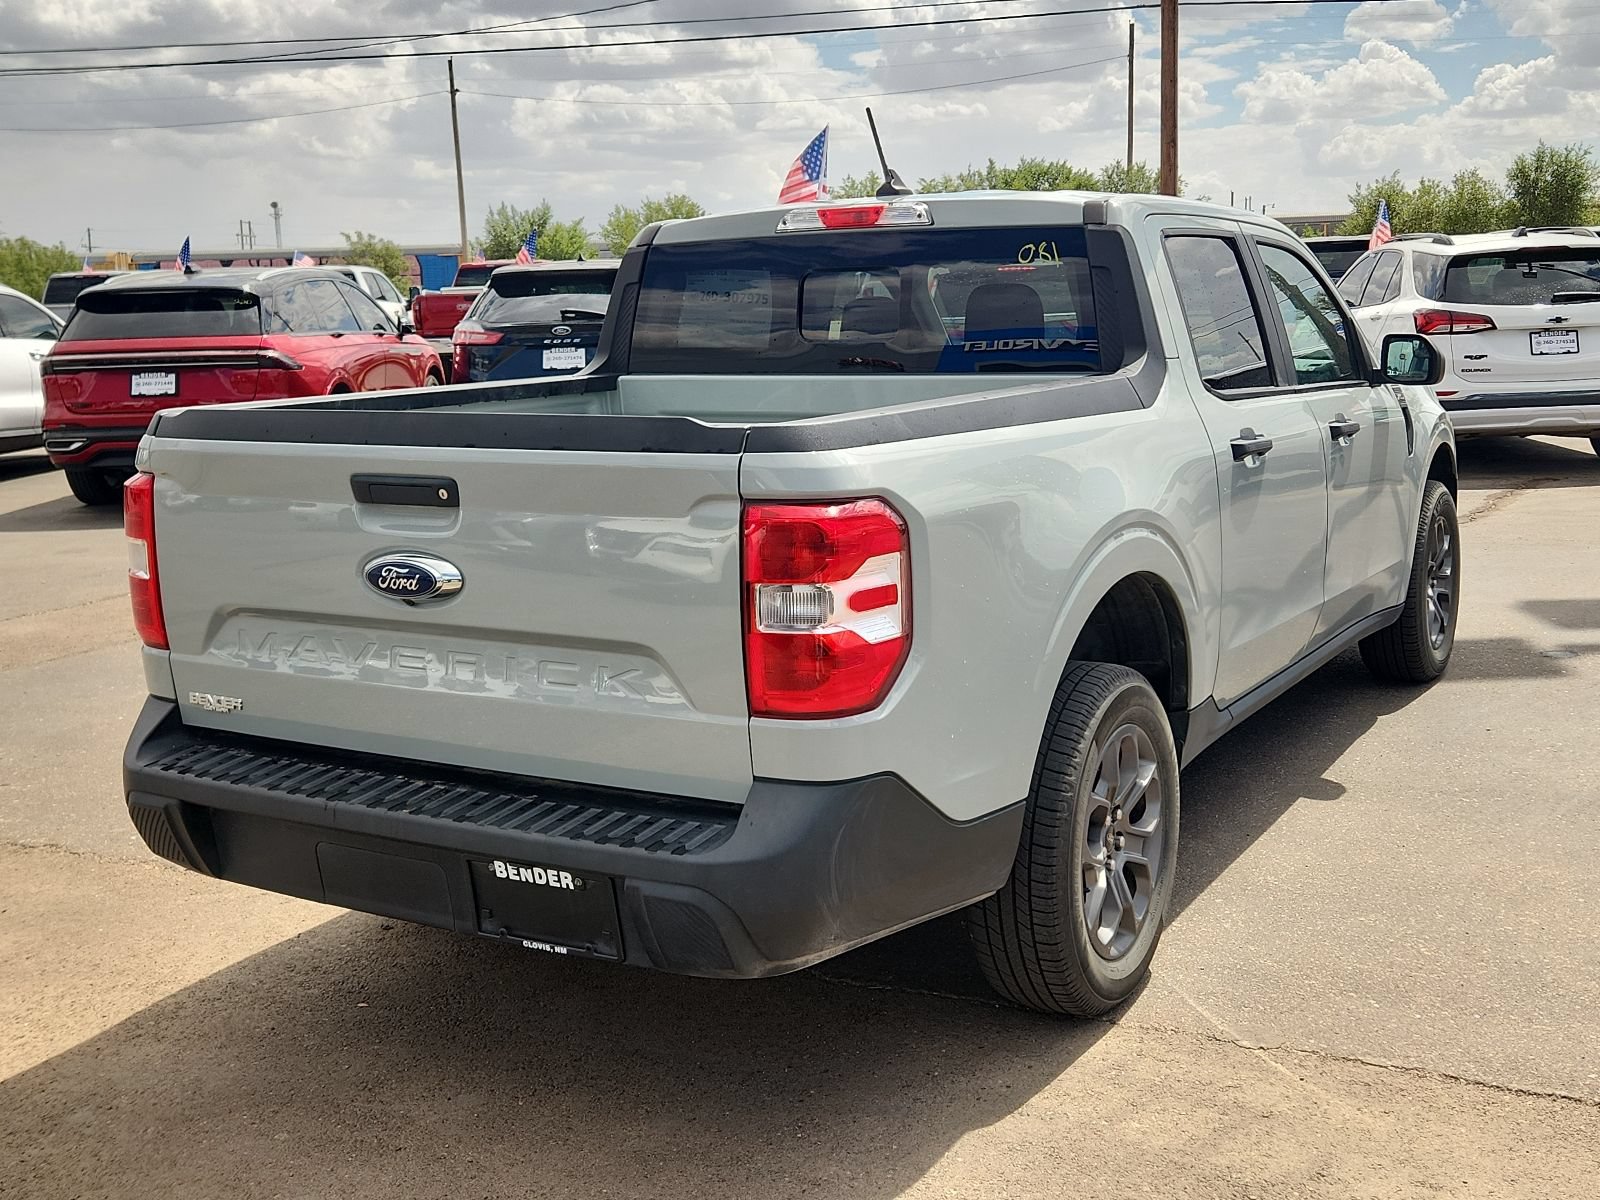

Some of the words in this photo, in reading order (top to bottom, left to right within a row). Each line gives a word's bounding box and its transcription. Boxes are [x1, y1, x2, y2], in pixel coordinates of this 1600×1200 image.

[378, 566, 420, 591] Ford
[236, 627, 648, 700] MAVERICK
[189, 692, 243, 711] BENDER
[493, 860, 575, 890] BENDER
[522, 940, 554, 953] CLOVIS,
[554, 945, 568, 955] NM
